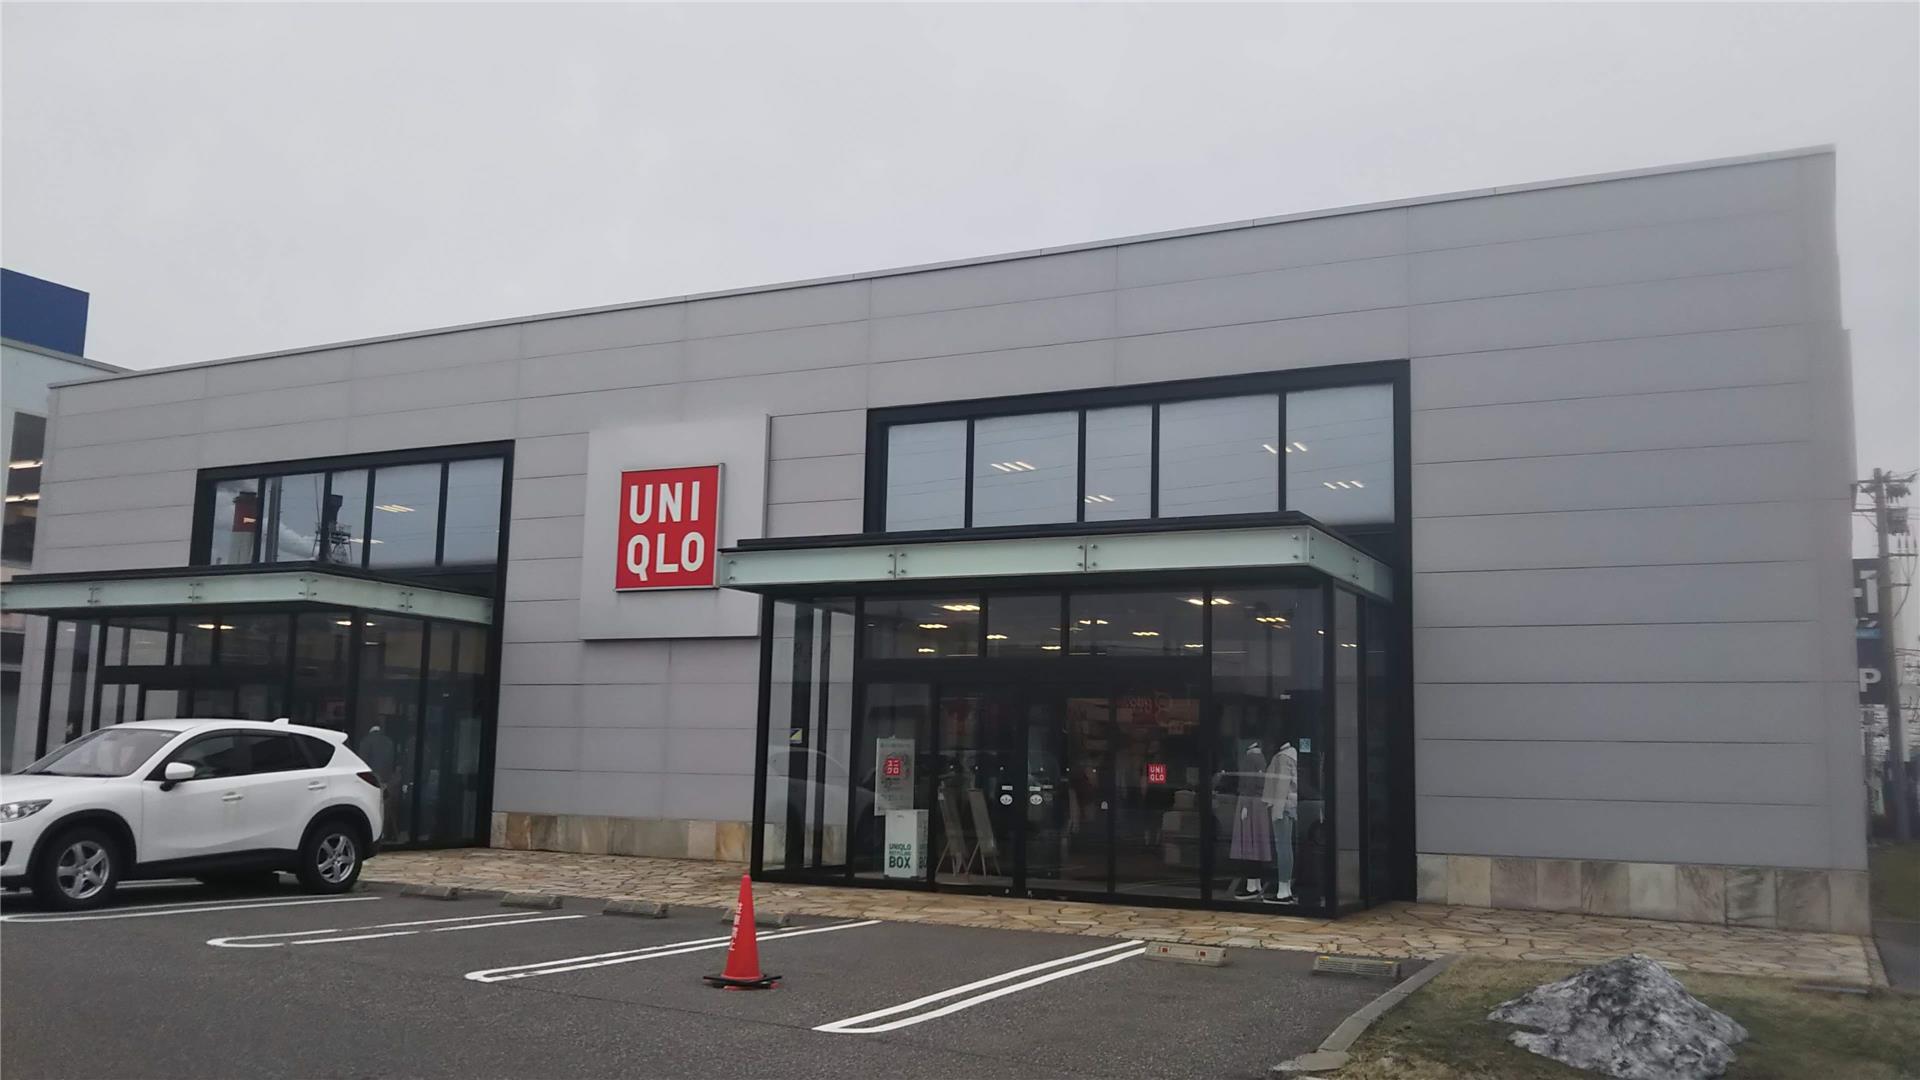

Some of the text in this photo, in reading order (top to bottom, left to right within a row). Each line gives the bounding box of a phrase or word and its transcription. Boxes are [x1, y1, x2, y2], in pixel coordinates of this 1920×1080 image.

[629, 480, 700, 524] UNI
[626, 531, 705, 581] QLO
[1150, 773, 1164, 782] QLO
[889, 856, 911, 868] BOX
